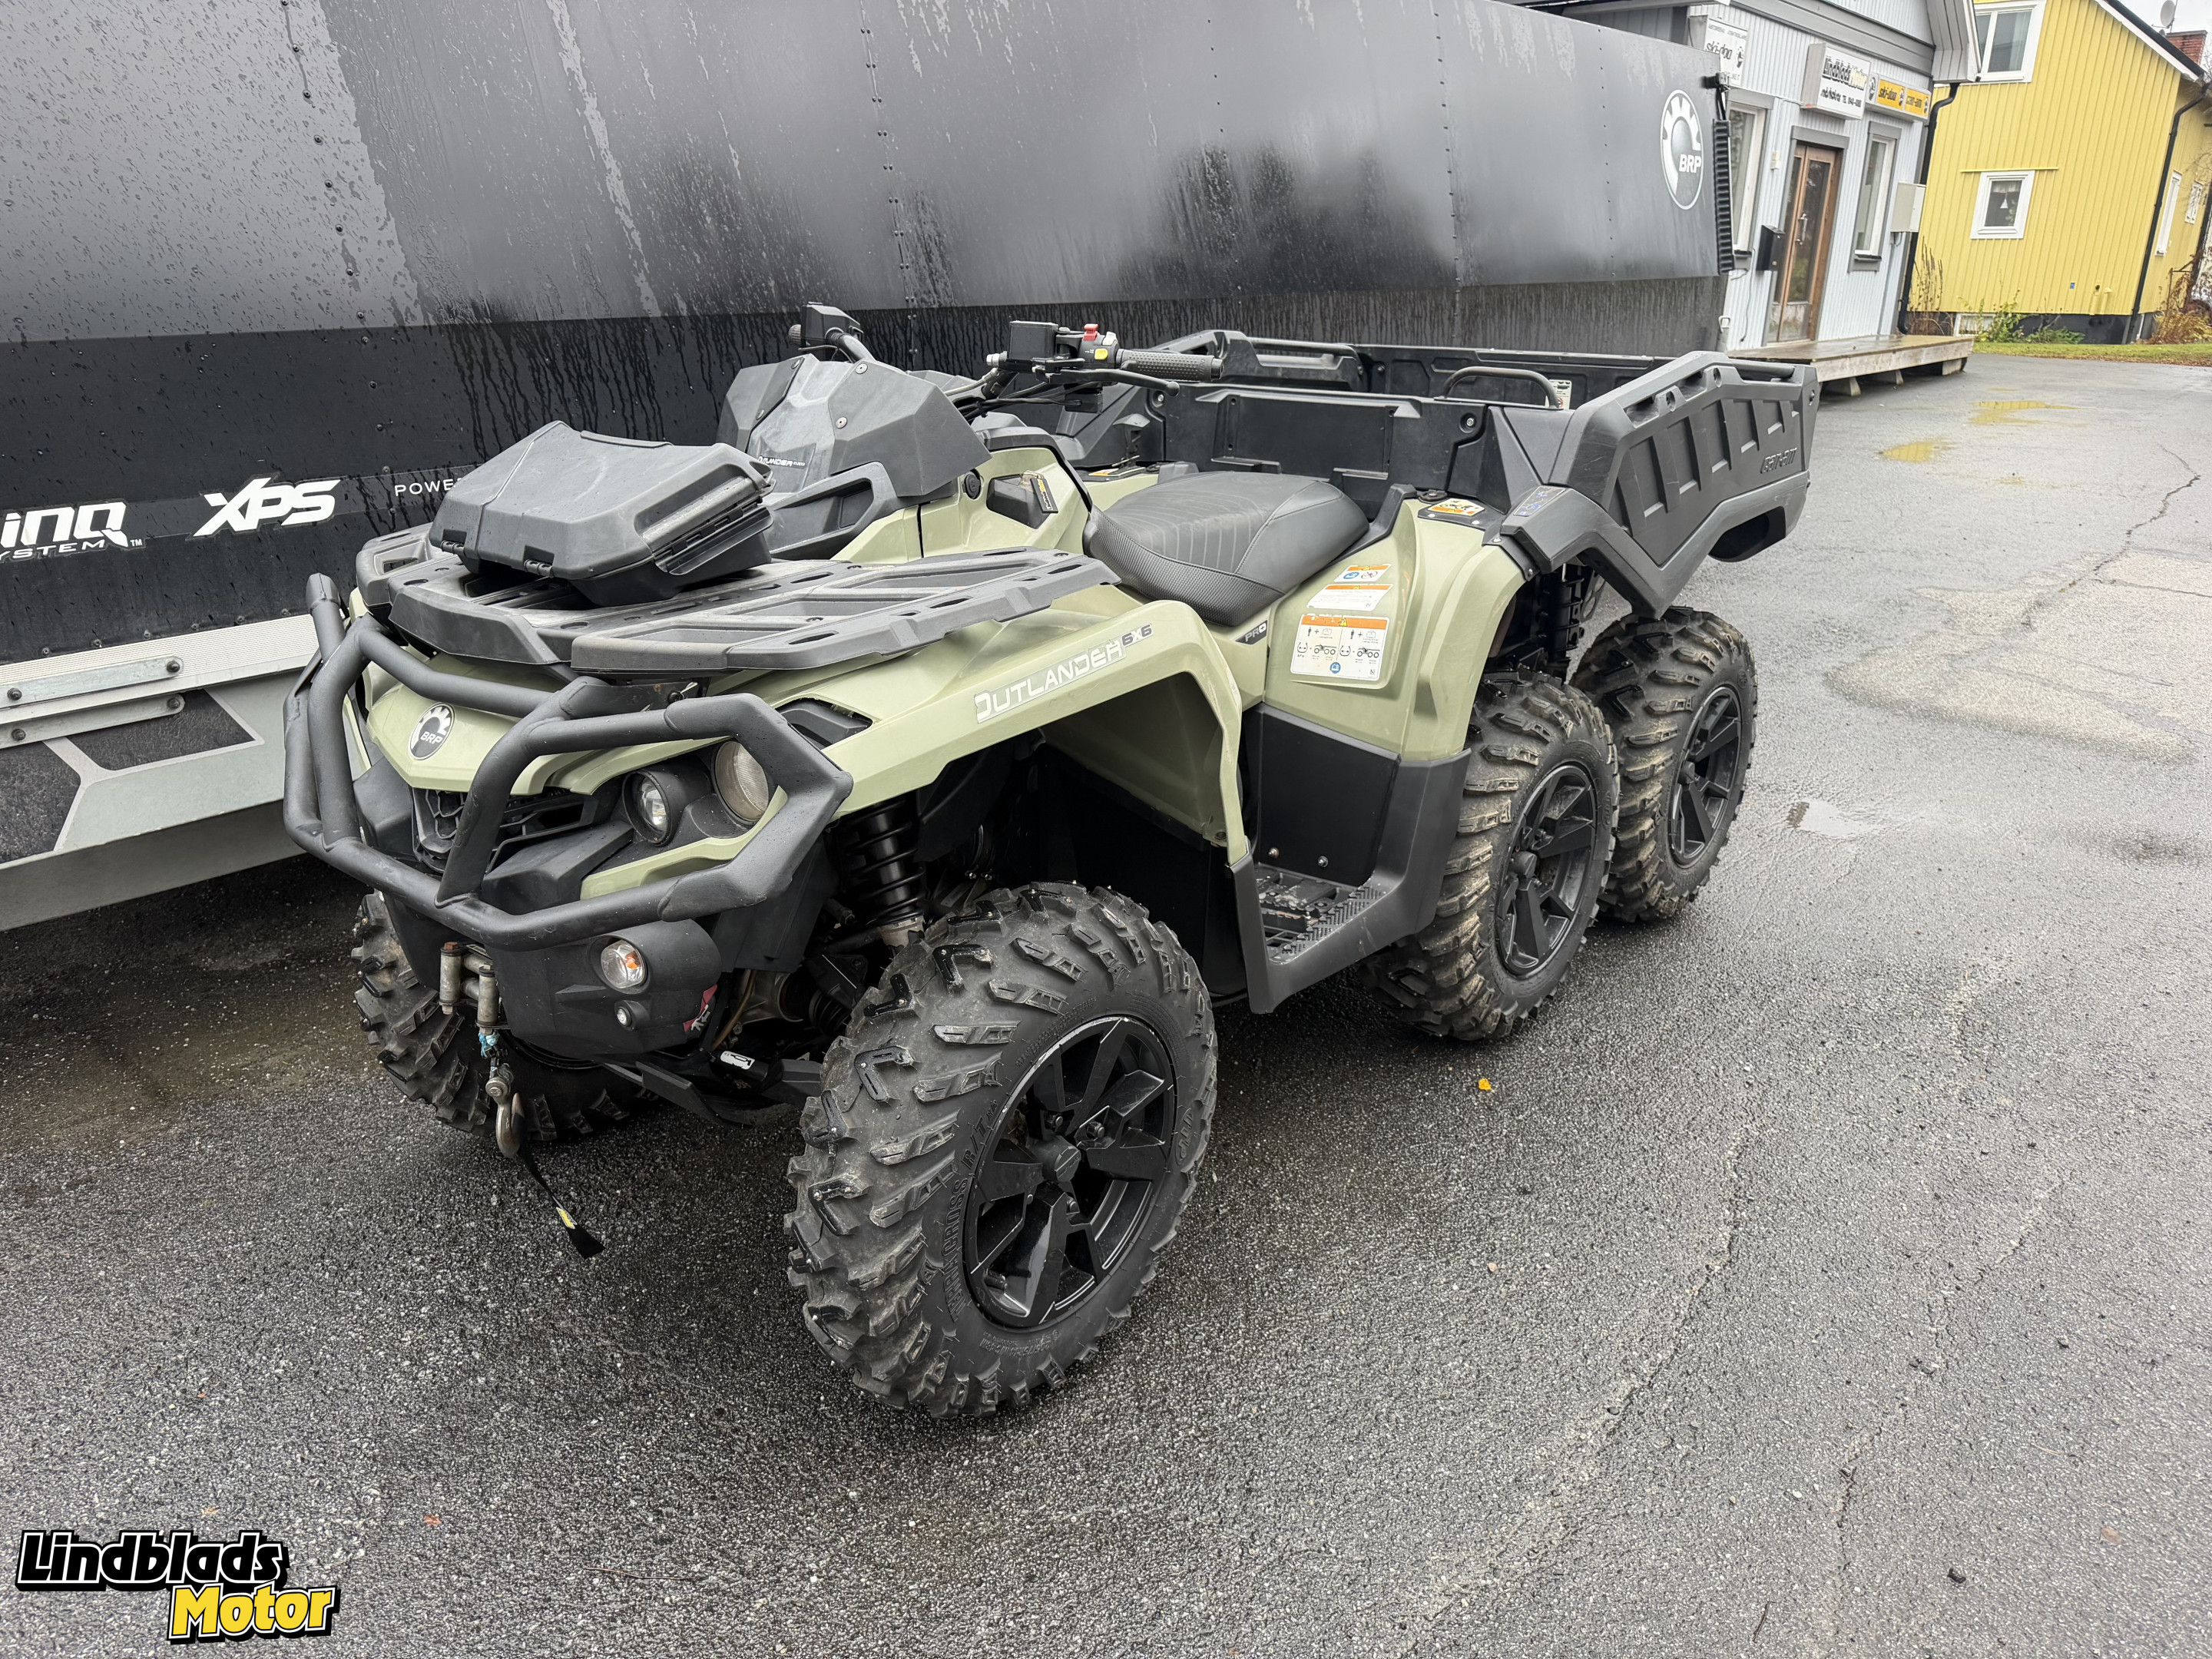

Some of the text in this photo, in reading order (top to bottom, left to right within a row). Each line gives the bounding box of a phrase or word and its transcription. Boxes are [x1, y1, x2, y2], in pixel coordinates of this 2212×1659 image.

[1679, 154, 1702, 174] BRP
[758, 455, 793, 466] OTLANDER
[194, 477, 340, 537] XPS
[975, 641, 1124, 722] OUTLANDER
[420, 731, 443, 745] BRP
[942, 1177, 969, 1257] CROSS
